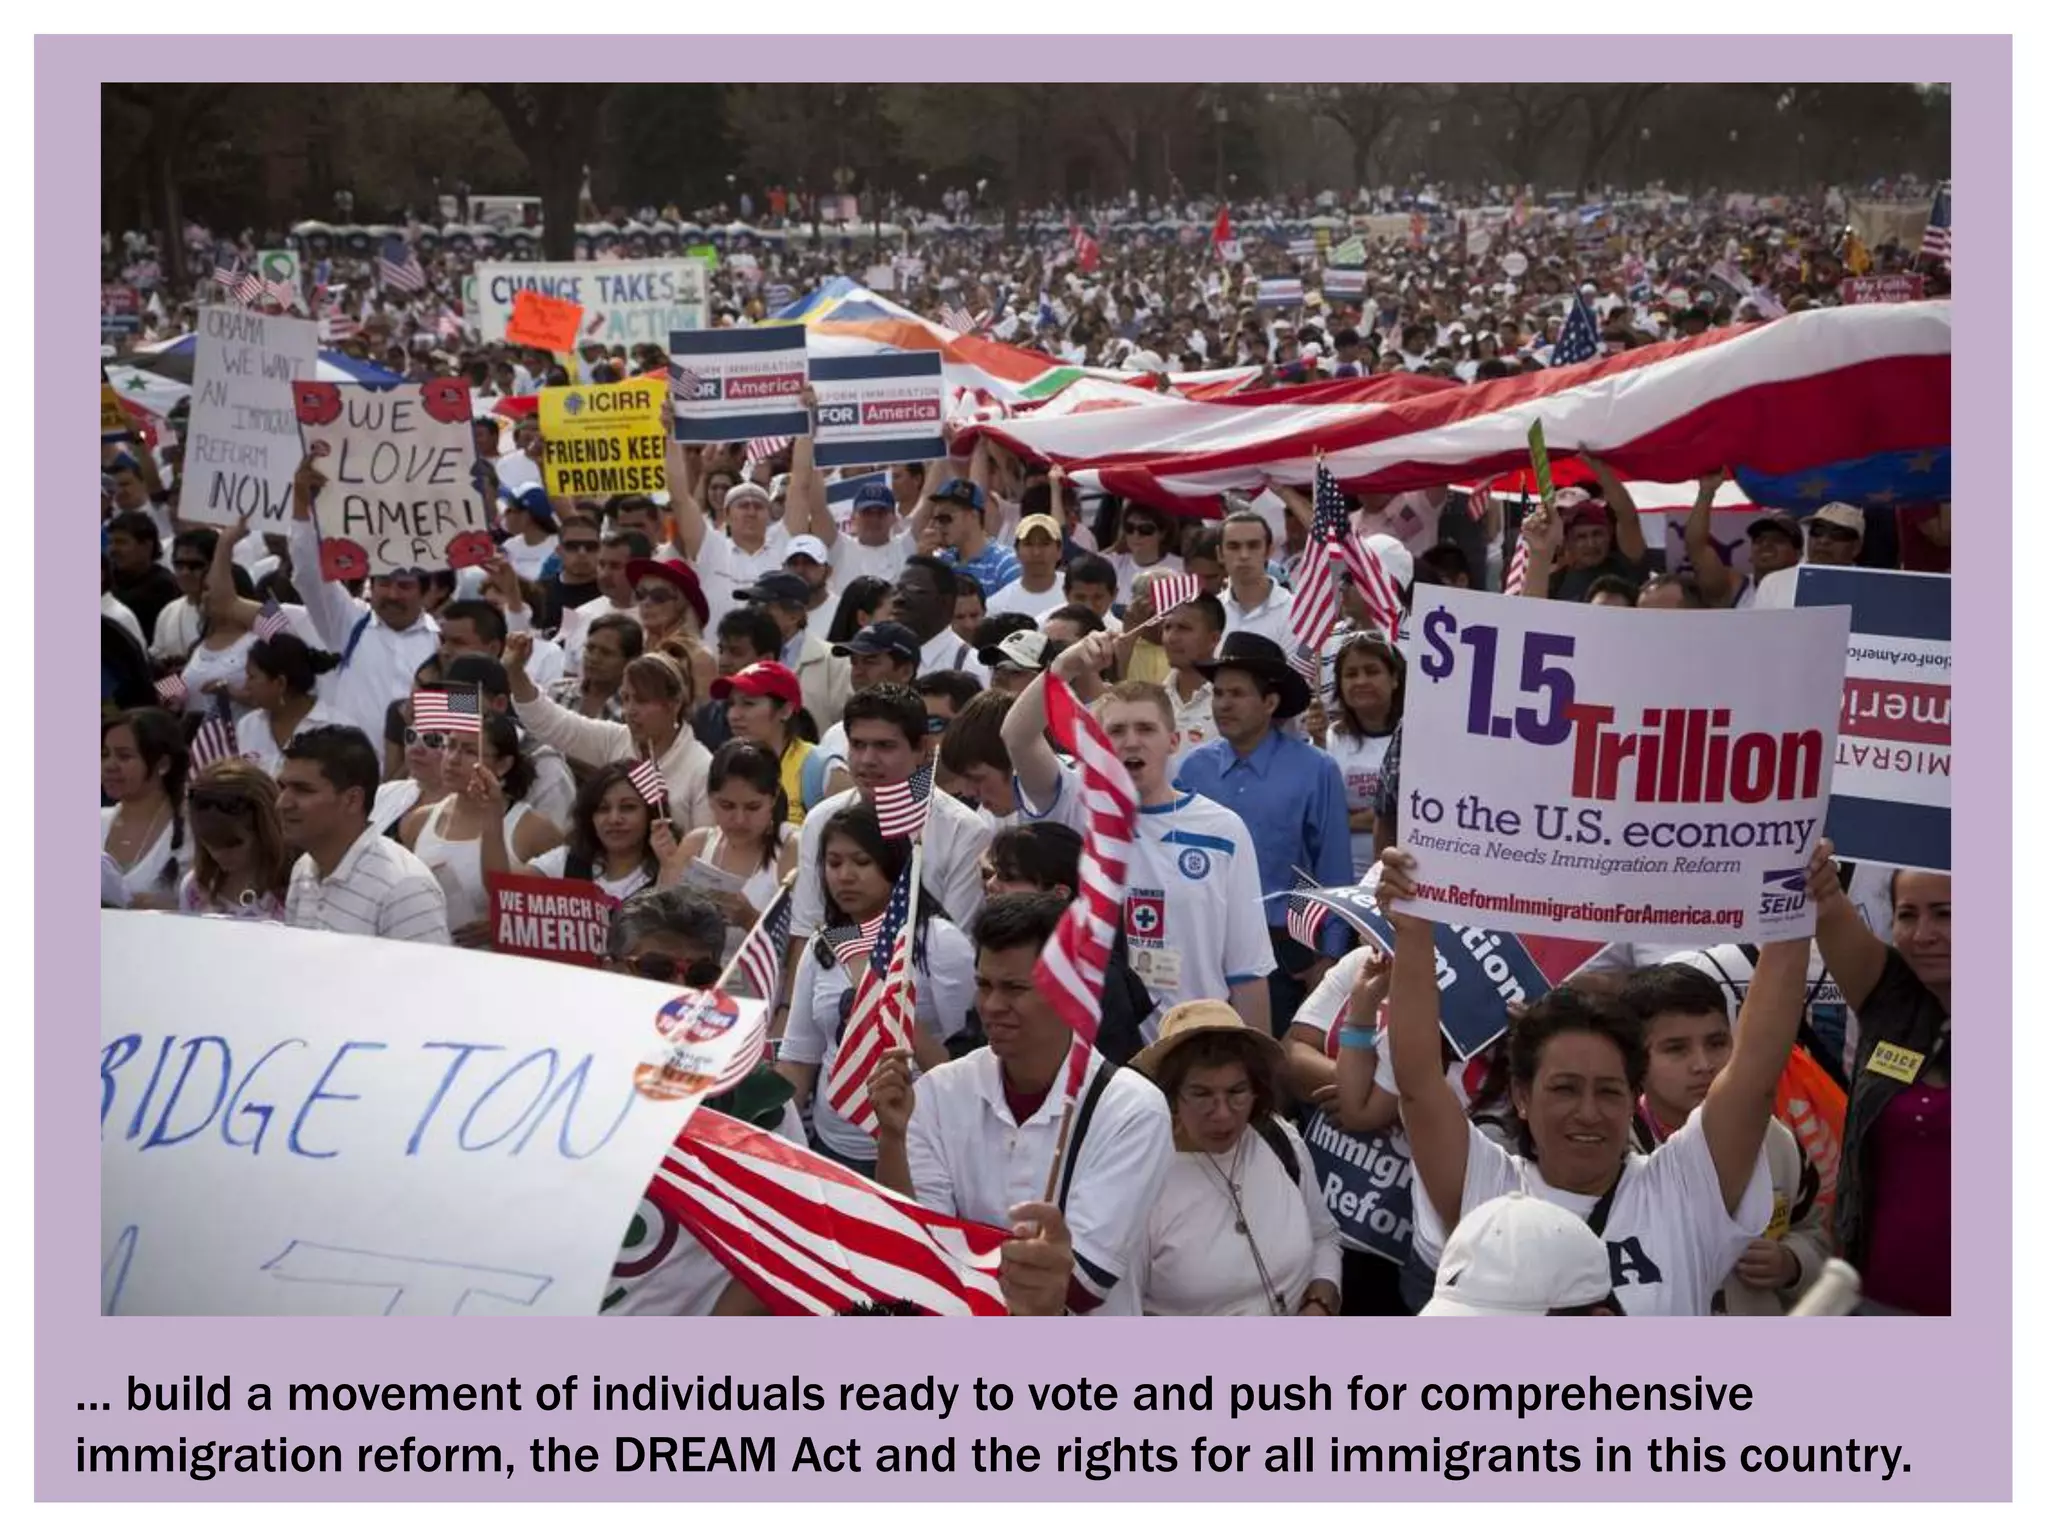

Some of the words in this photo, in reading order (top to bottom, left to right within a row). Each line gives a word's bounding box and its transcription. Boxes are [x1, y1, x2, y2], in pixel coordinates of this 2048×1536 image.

[491, 275, 583, 305] CHANGE
[595, 271, 675, 301] TAKES
[222, 345, 254, 377] WE
[200, 379, 228, 408] AN
[589, 390, 651, 412] ICIRR
[693, 382, 717, 397] OR
[729, 378, 800, 397] America
[348, 399, 416, 433] WE
[818, 407, 853, 422] FOR
[867, 402, 937, 421] America
[338, 437, 463, 485] LOVE
[545, 437, 622, 464] FRIENDS
[558, 465, 666, 493] PROMISES
[208, 471, 293, 521] NOW
[343, 495, 474, 536] AMERI
[377, 538, 438, 567] CA
[1420, 605, 1575, 746] $1.5
[1564, 703, 1823, 804] Trillion
[1835, 742, 1951, 777] MIGRAT
[1410, 788, 1444, 824] to
[1456, 795, 1521, 836] the
[1533, 803, 1611, 846] U.S.
[1623, 818, 1817, 854] economy
[1408, 828, 1481, 857] America
[1484, 841, 1548, 866] Needs
[1551, 849, 1667, 876] Immigration
[1672, 856, 1741, 874] Reform
[498, 889, 524, 912] WE
[527, 893, 593, 920] MARCH
[1758, 893, 1806, 914] SEIU
